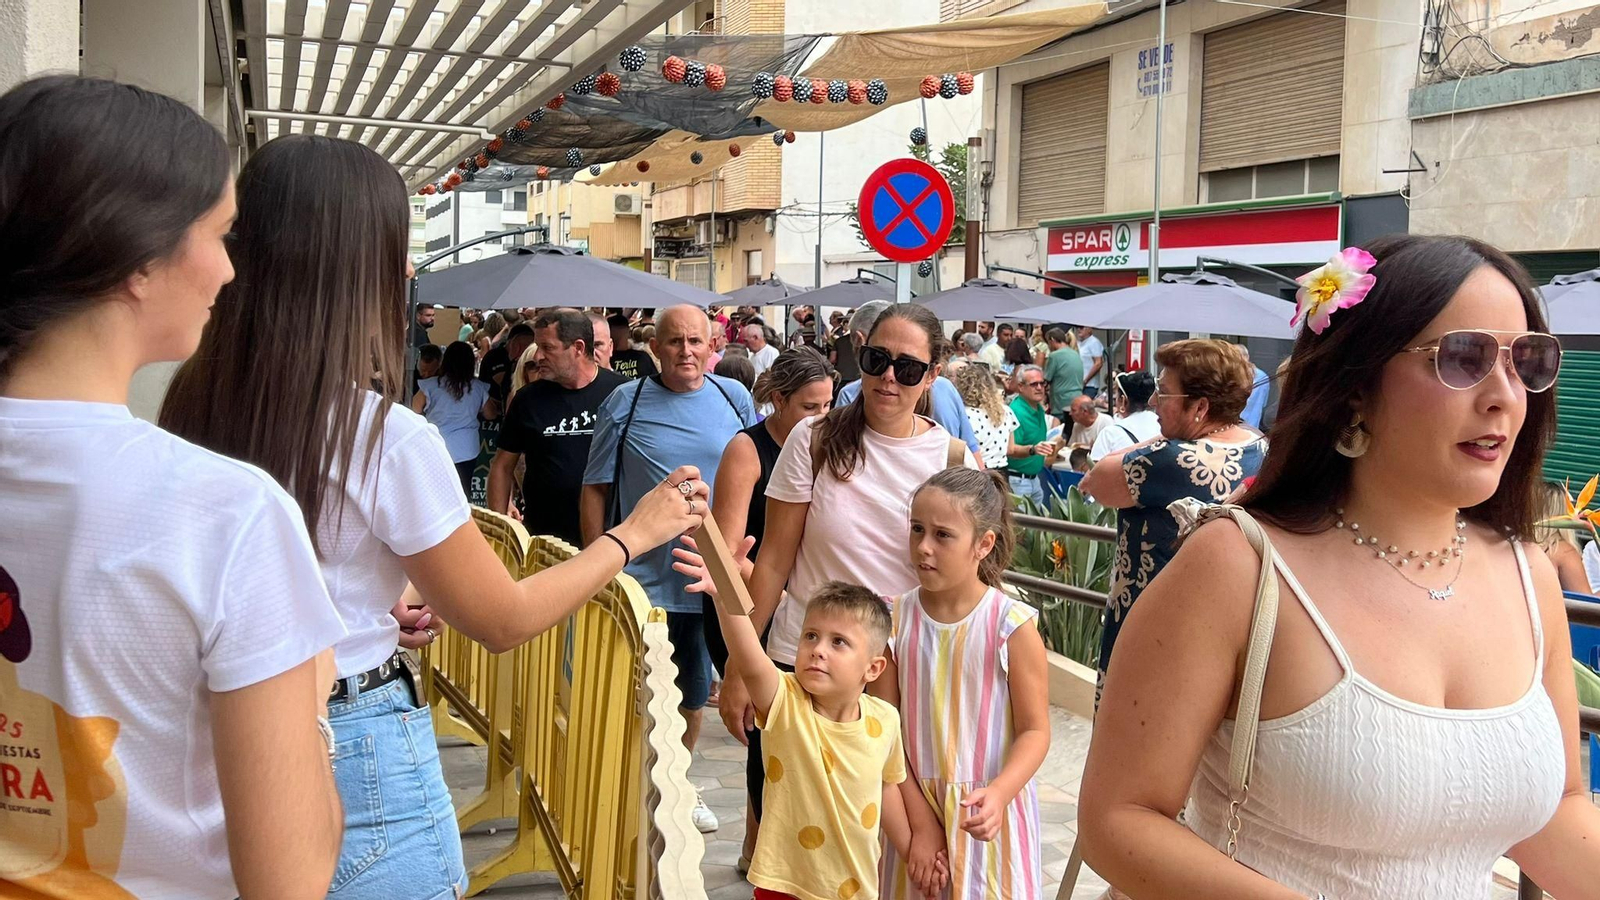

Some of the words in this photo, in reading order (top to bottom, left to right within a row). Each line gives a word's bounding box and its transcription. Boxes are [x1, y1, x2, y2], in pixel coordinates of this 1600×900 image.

[1138, 50, 1147, 70] SE
[1149, 43, 1174, 67] VEDE
[1061, 229, 1112, 250] SPAR
[1074, 254, 1130, 270] express
